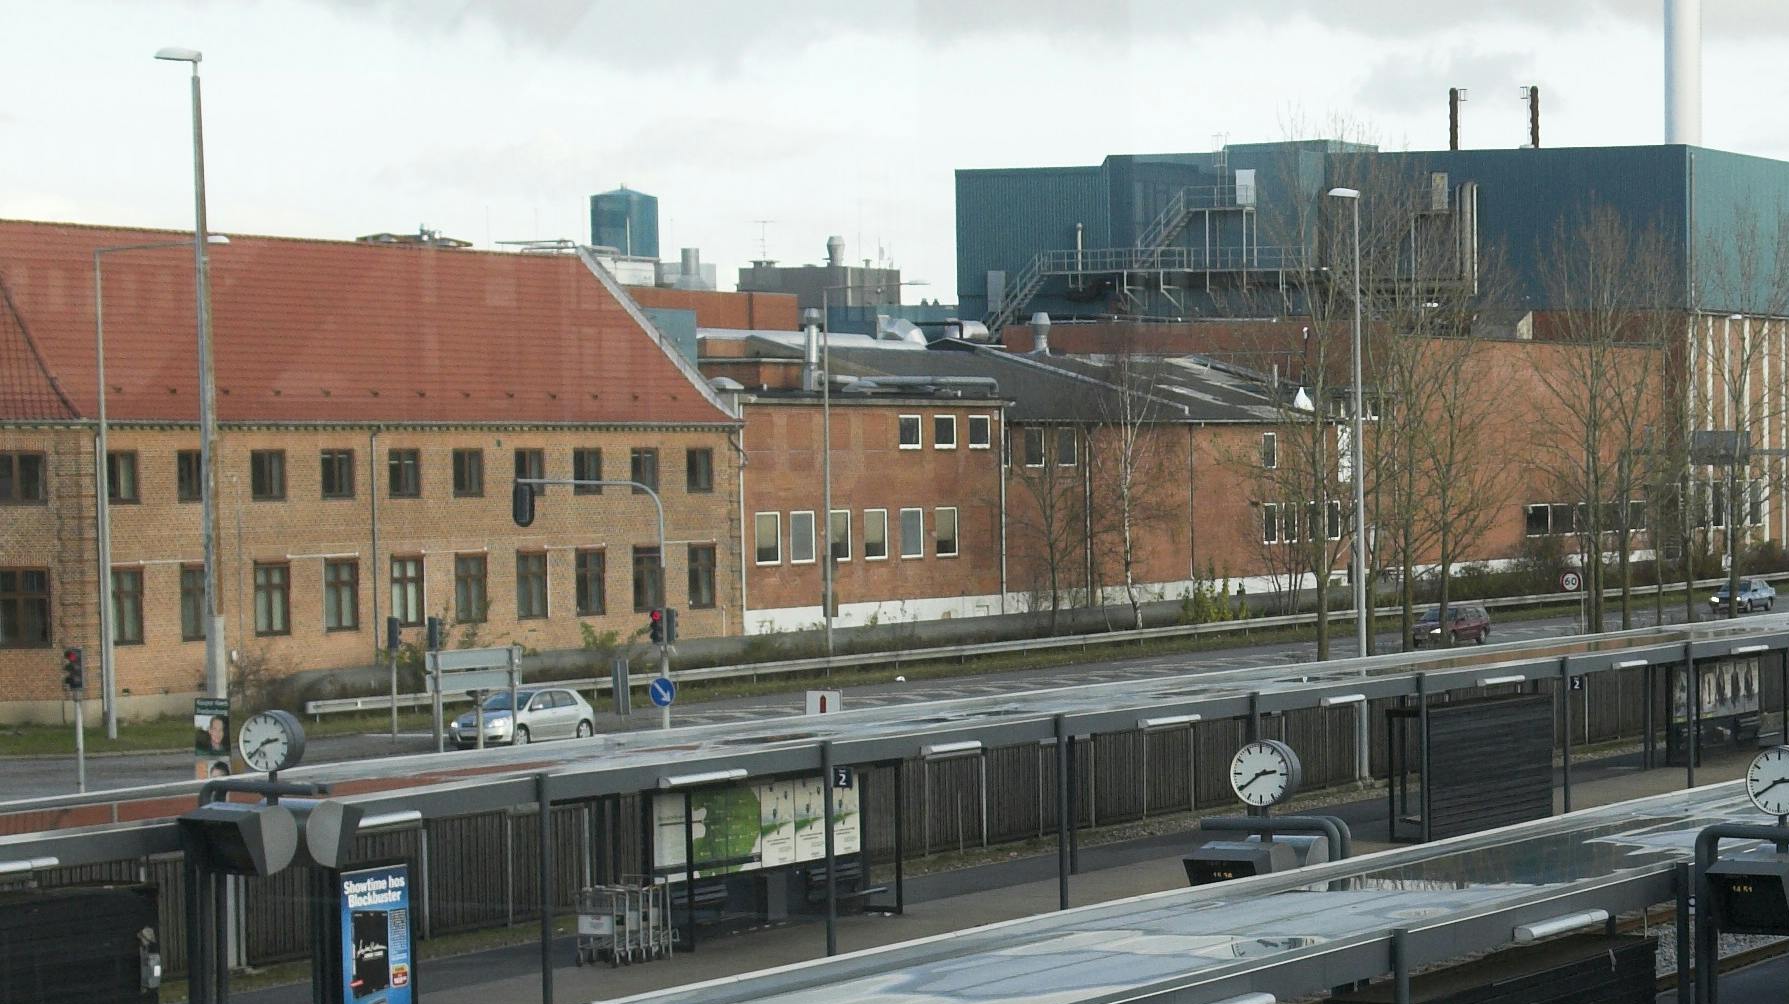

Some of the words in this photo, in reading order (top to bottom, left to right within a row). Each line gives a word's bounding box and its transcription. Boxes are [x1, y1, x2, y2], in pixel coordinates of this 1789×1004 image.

[1565, 577, 1577, 585] 60
[1574, 680, 1580, 688] 2
[839, 773, 846, 786] 2
[343, 877, 387, 895] Showtime
[388, 874, 406, 889] hos
[347, 889, 402, 908] Blockbuster
